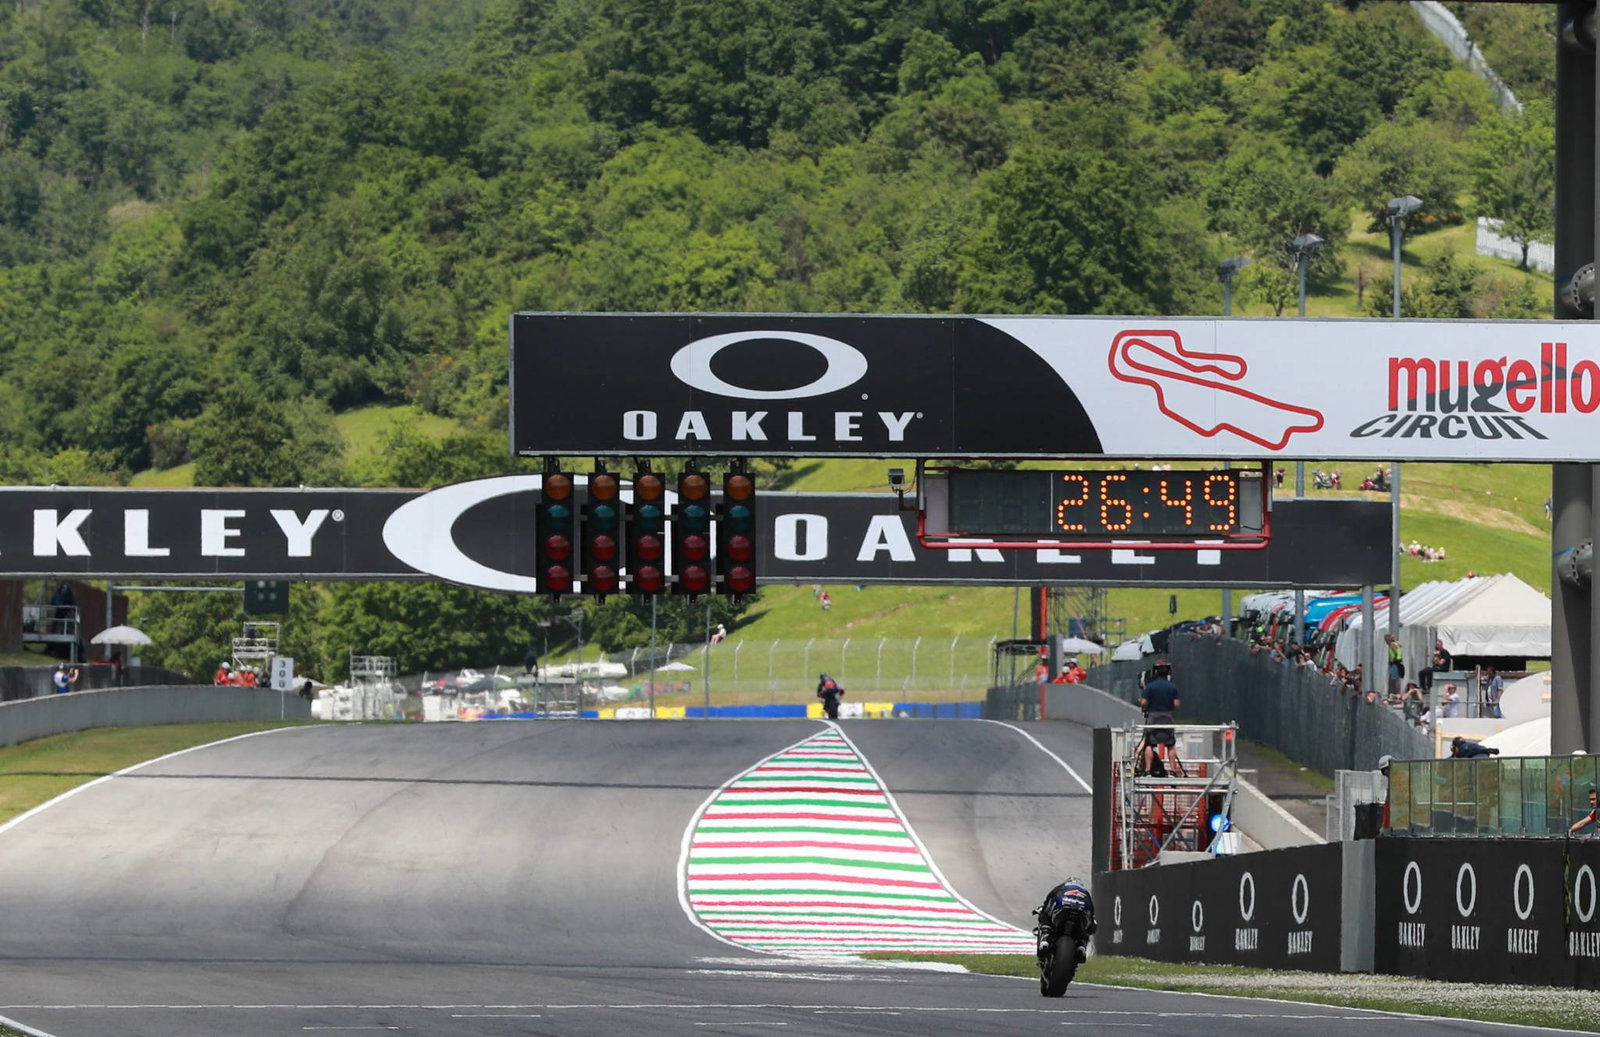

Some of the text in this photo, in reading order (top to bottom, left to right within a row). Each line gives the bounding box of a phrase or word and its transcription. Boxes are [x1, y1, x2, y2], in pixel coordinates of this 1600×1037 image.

[1388, 342, 1600, 414] mugello
[624, 410, 915, 442] OAKLEY
[1350, 413, 1549, 440] CIRCUIT
[1058, 474, 1235, 530] 26:49
[0, 508, 330, 557] KLEY
[1399, 921, 1426, 947] OAKLEY
[1452, 925, 1481, 950] OAKLEY
[1508, 928, 1539, 954] OAKLEY
